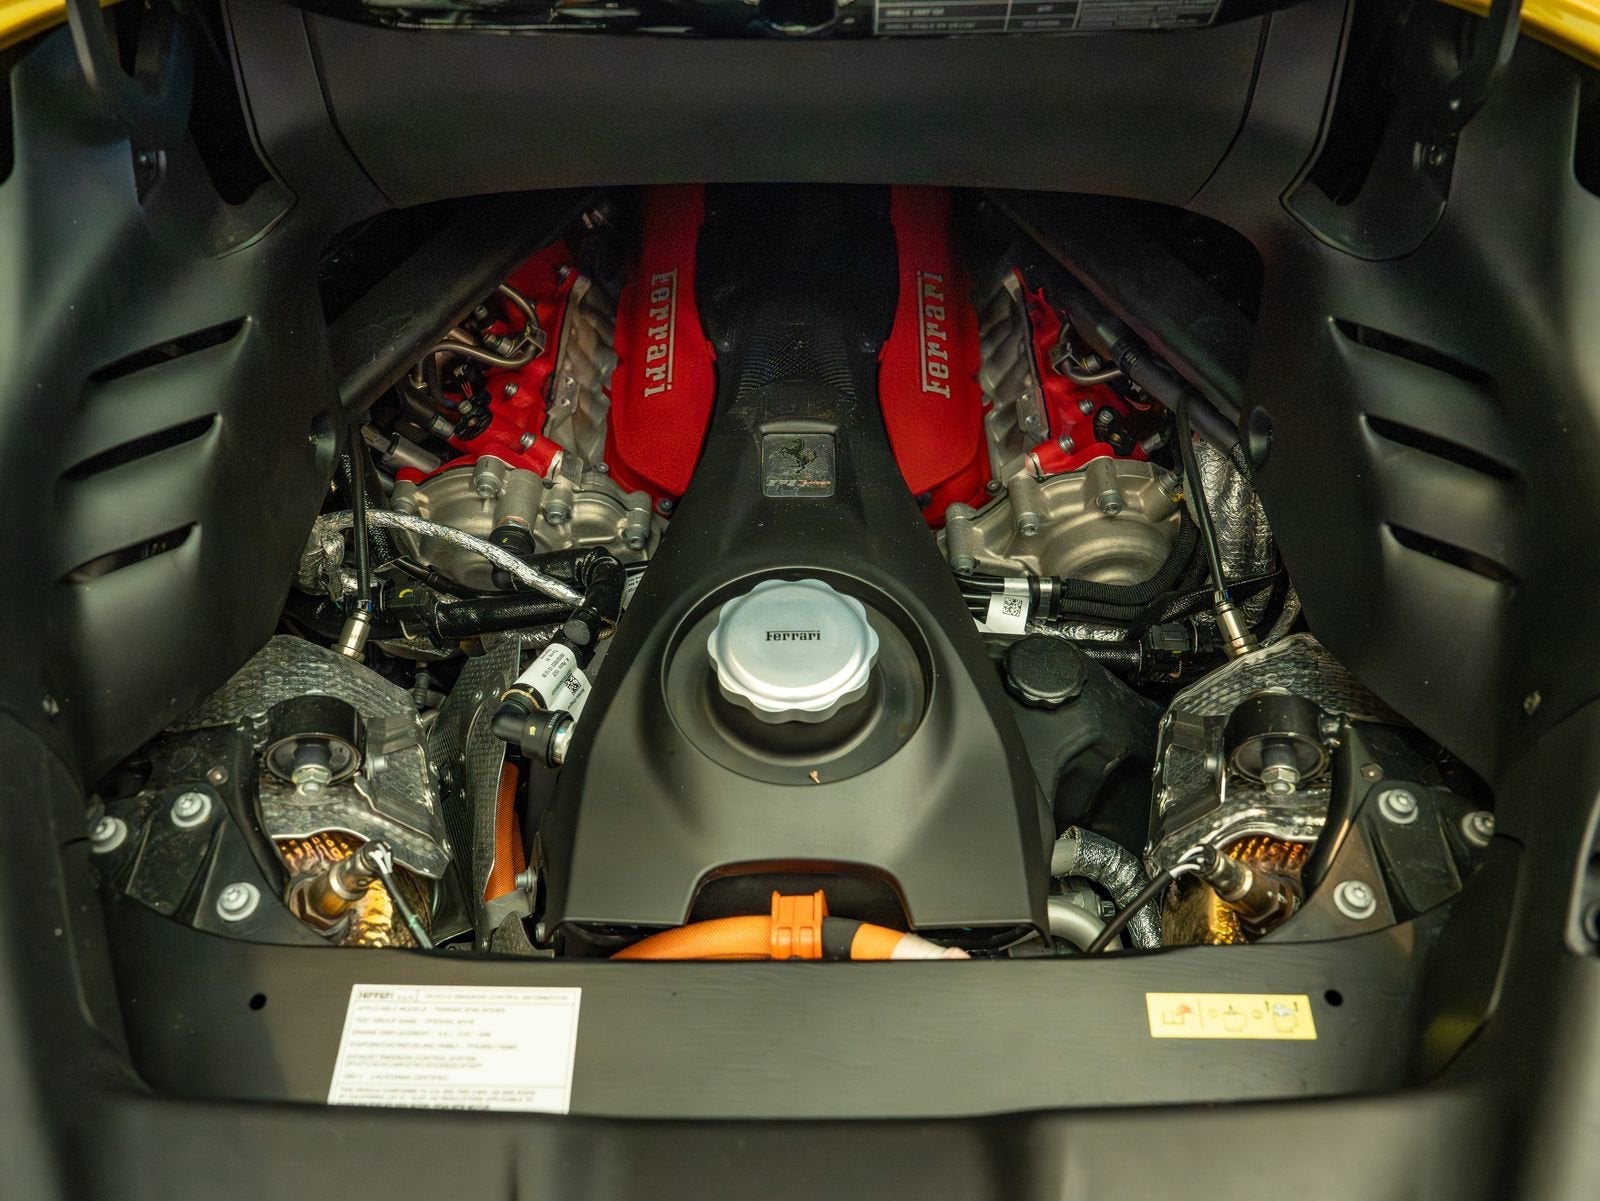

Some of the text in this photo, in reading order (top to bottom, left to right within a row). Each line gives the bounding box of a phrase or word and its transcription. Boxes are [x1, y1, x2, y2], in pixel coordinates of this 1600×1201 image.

[643, 268, 677, 398] Ferrari
[917, 270, 951, 399] Ferrari
[766, 630, 821, 641] Ferrari
